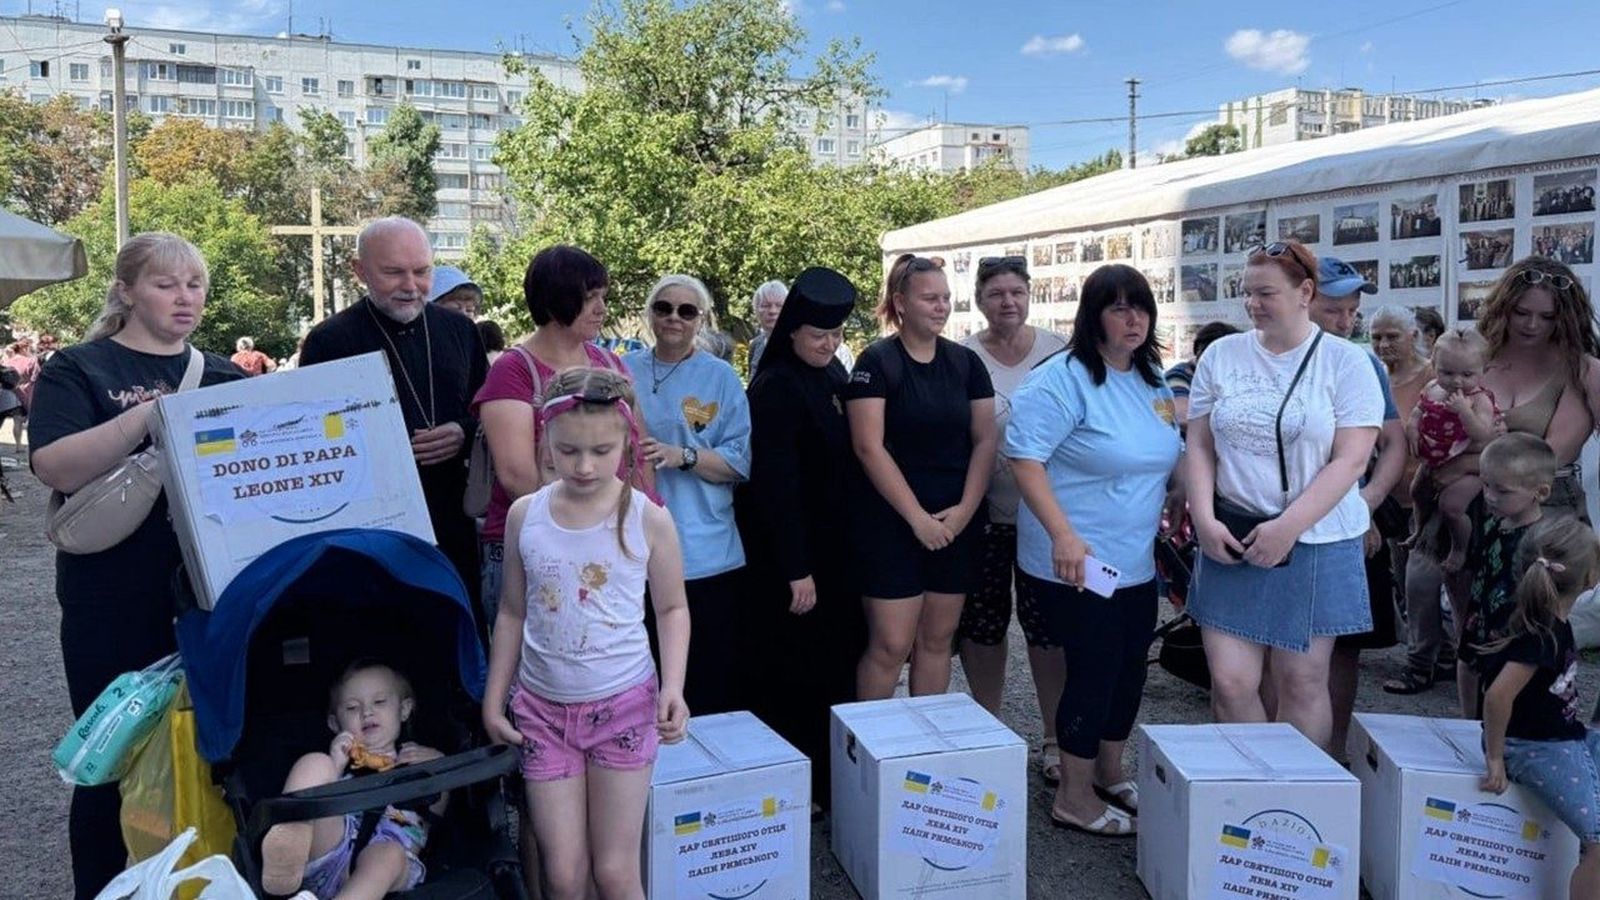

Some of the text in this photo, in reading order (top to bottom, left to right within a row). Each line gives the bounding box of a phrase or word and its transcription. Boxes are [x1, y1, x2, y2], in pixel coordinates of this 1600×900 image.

[213, 444, 357, 477] DONO DI PAPA
[233, 470, 345, 500] LEONE XIV
[113, 687, 126, 698] 2
[901, 800, 999, 829] ДАР СВЯТІШОГО ОТЦЯ
[678, 823, 786, 855] ДАР СВЯТІШОГО ОТЦЯ
[902, 826, 984, 851] ПАПИ РИМСЬКОГО
[951, 825, 970, 835] XIV
[1424, 827, 1546, 861] ДАР СВЯТІШОГО ОТЦЯ
[688, 850, 779, 878] ПАПИ РИМСЬКОГО
[710, 842, 758, 860] ЛЕВА XIV
[1456, 847, 1509, 865] ЛЕВА XIV
[1219, 854, 1333, 888] ДАР СВЯТІШОГО ОТЦЯ
[1429, 853, 1530, 883] ПАПИ РИМСЬКОГО
[1222, 882, 1253, 896] ПАПИ
[1248, 874, 1299, 893] ЛЕВА XIV
